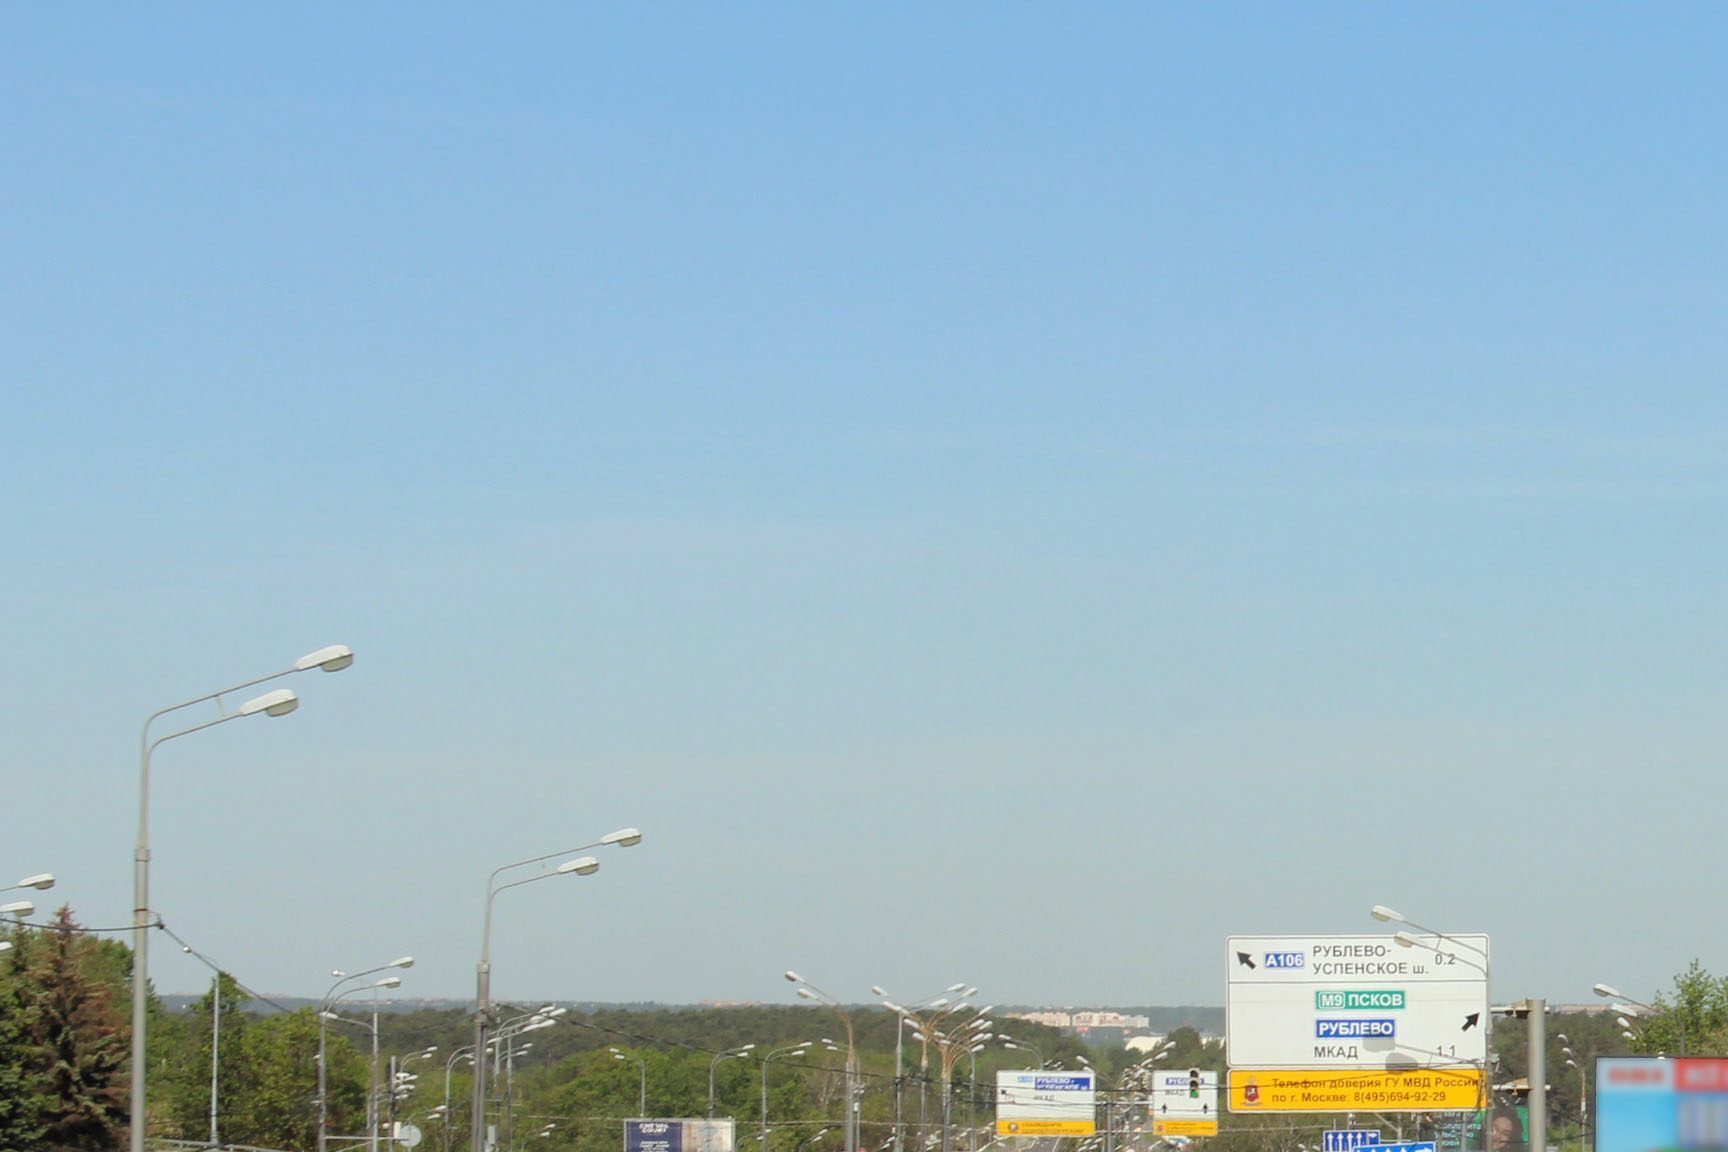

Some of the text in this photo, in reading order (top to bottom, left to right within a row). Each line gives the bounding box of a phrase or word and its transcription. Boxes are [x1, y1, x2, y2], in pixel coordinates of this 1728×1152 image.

[1312, 945, 1392, 957] РУБЛЕВО-
[1312, 962, 1430, 975] УСПЕНСКОЕ ш.
[1348, 993, 1403, 1006] ПСКОВ
[1319, 1022, 1394, 1036] РУБЛЕВО
[1314, 1045, 1358, 1060] МКАД
[1329, 1079, 1381, 1090] доверия
[1385, 1078, 1400, 1088] ГУ
[1402, 1077, 1431, 1088] МВД
[1272, 1094, 1287, 1102] по
